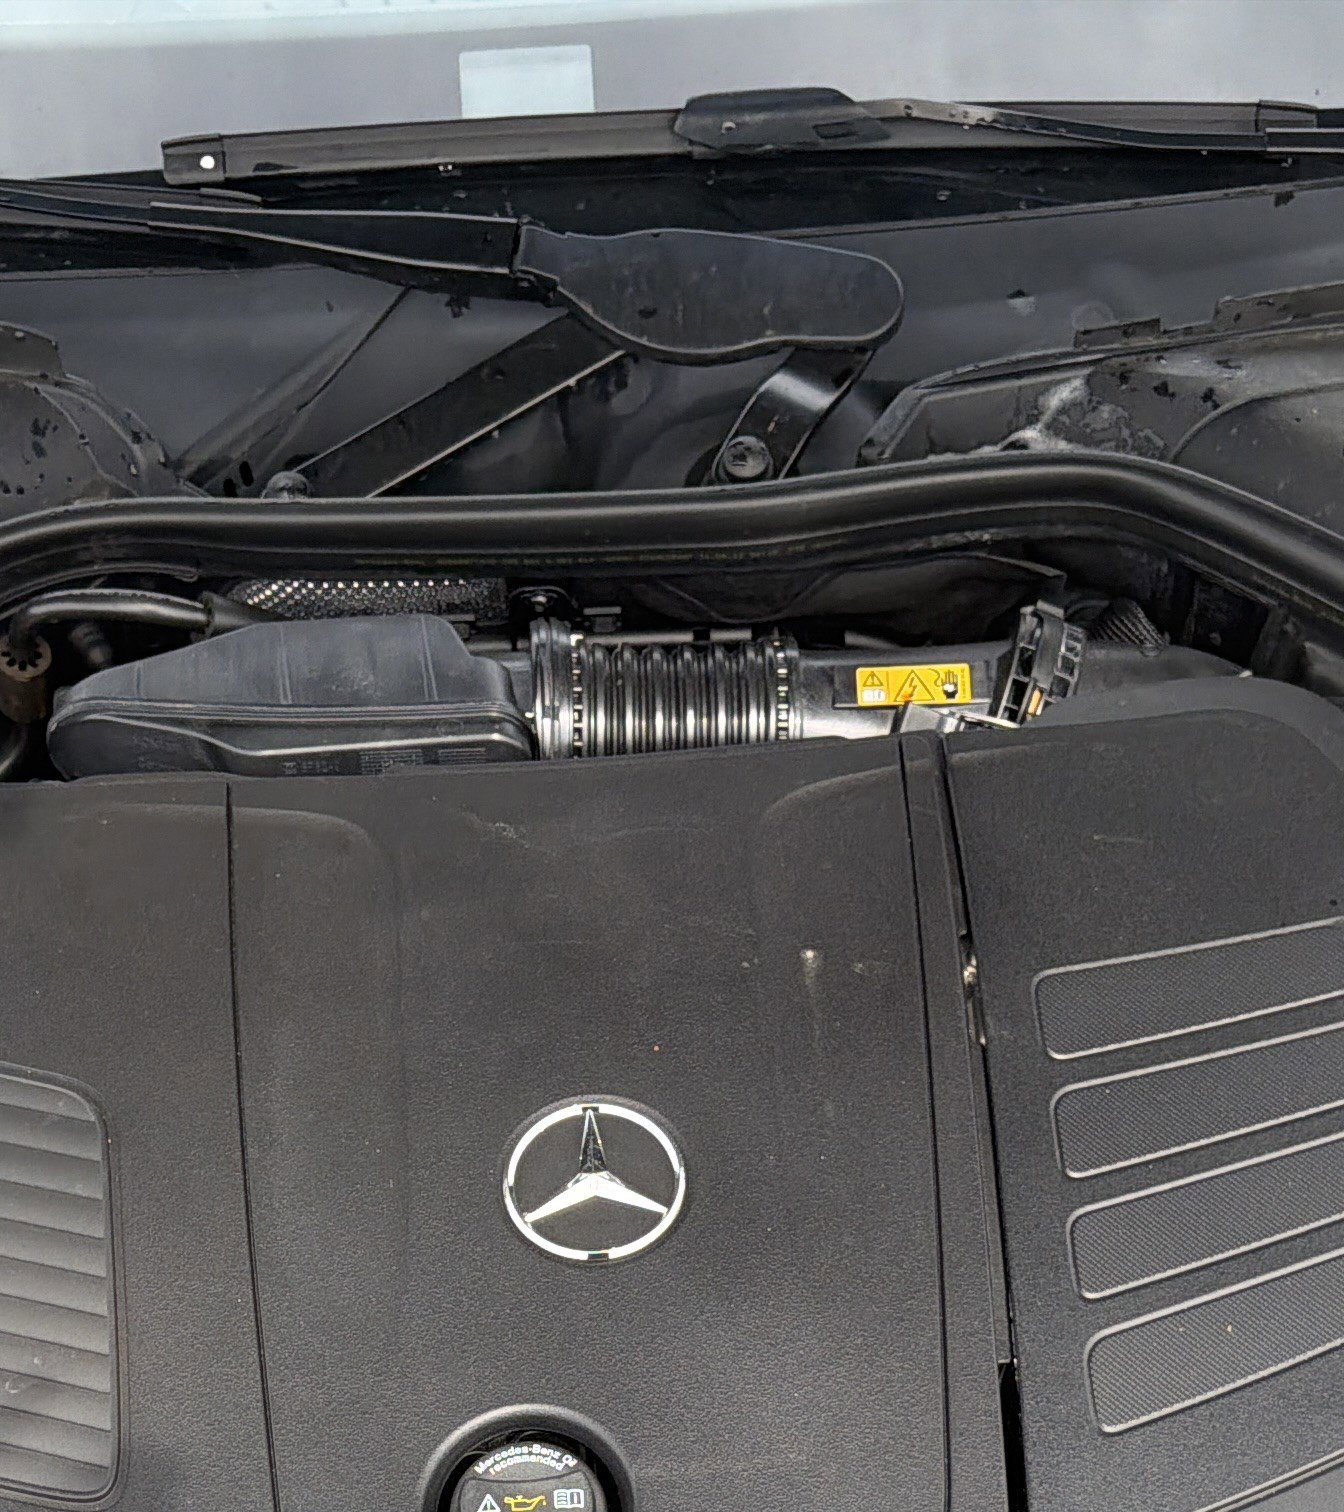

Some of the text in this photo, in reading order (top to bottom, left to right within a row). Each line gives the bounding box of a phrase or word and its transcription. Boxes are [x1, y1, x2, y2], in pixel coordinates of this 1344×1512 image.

[474, 1445, 577, 1474] Mercedes-Benz Oil
[489, 1454, 565, 1475] recommended
